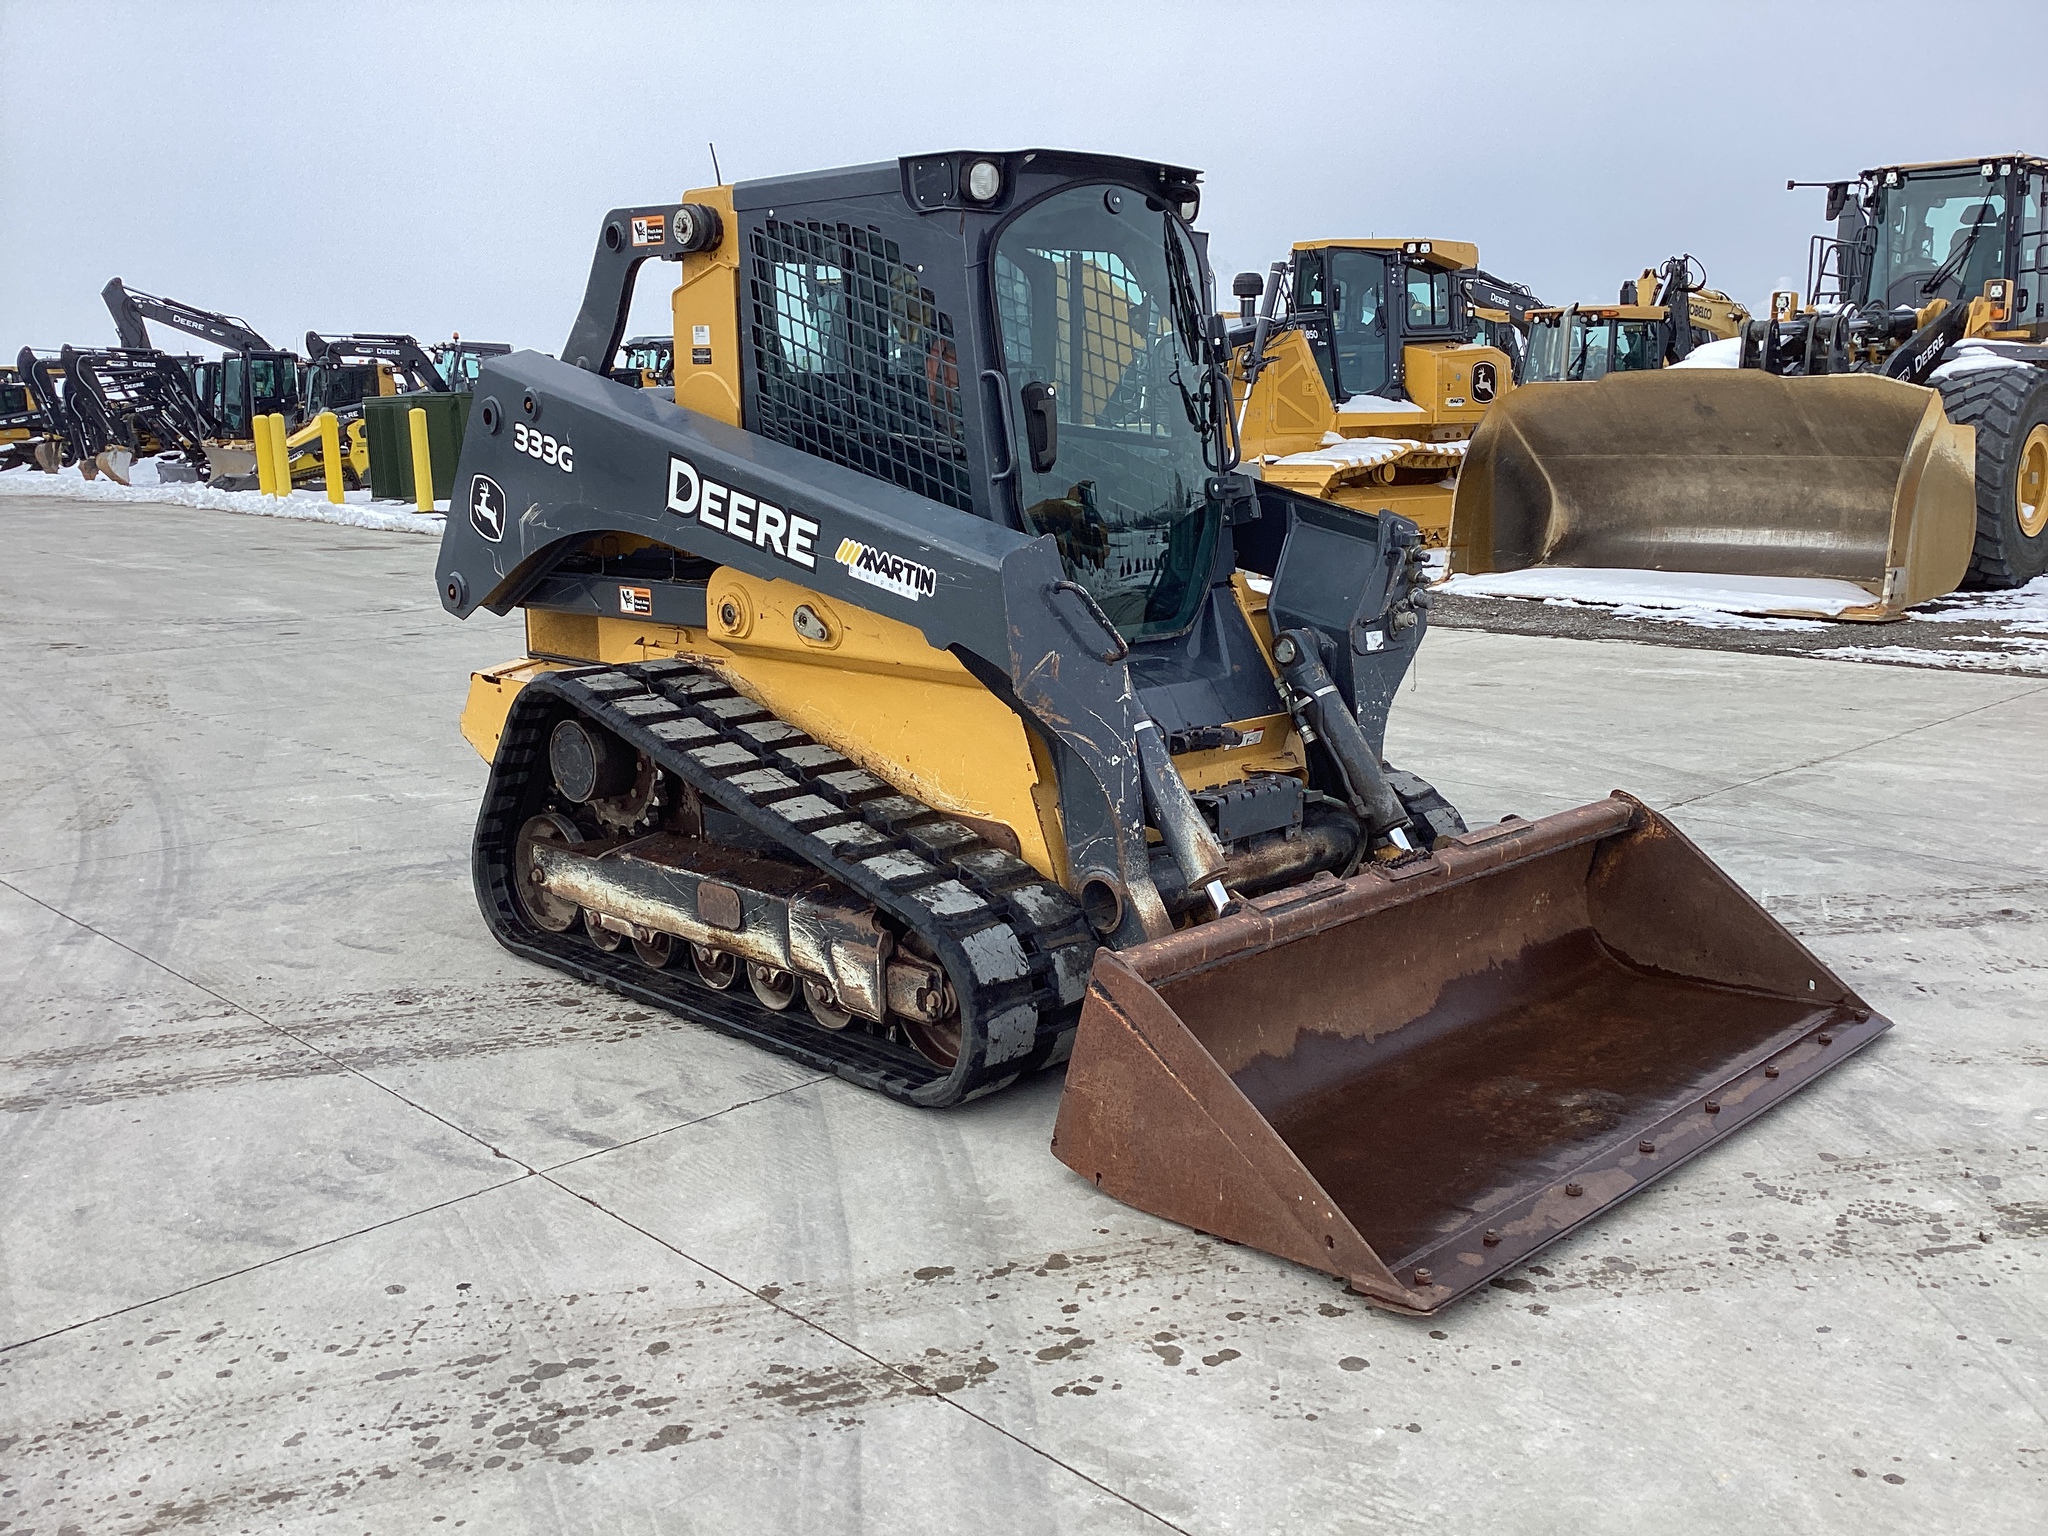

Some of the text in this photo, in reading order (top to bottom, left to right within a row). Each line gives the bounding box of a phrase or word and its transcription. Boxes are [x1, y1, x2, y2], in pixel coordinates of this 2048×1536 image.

[1490, 292, 1510, 307] DEERE
[1689, 303, 1712, 320] OBELCO
[173, 314, 205, 330] DEERE
[1305, 330, 1319, 339] 850
[377, 347, 400, 355] DEERE
[1914, 332, 1944, 373] DEERE
[514, 423, 573, 473] 333G
[668, 457, 819, 568] DEERE
[849, 566, 919, 598] Equipment
[856, 547, 934, 594] MARTIN
